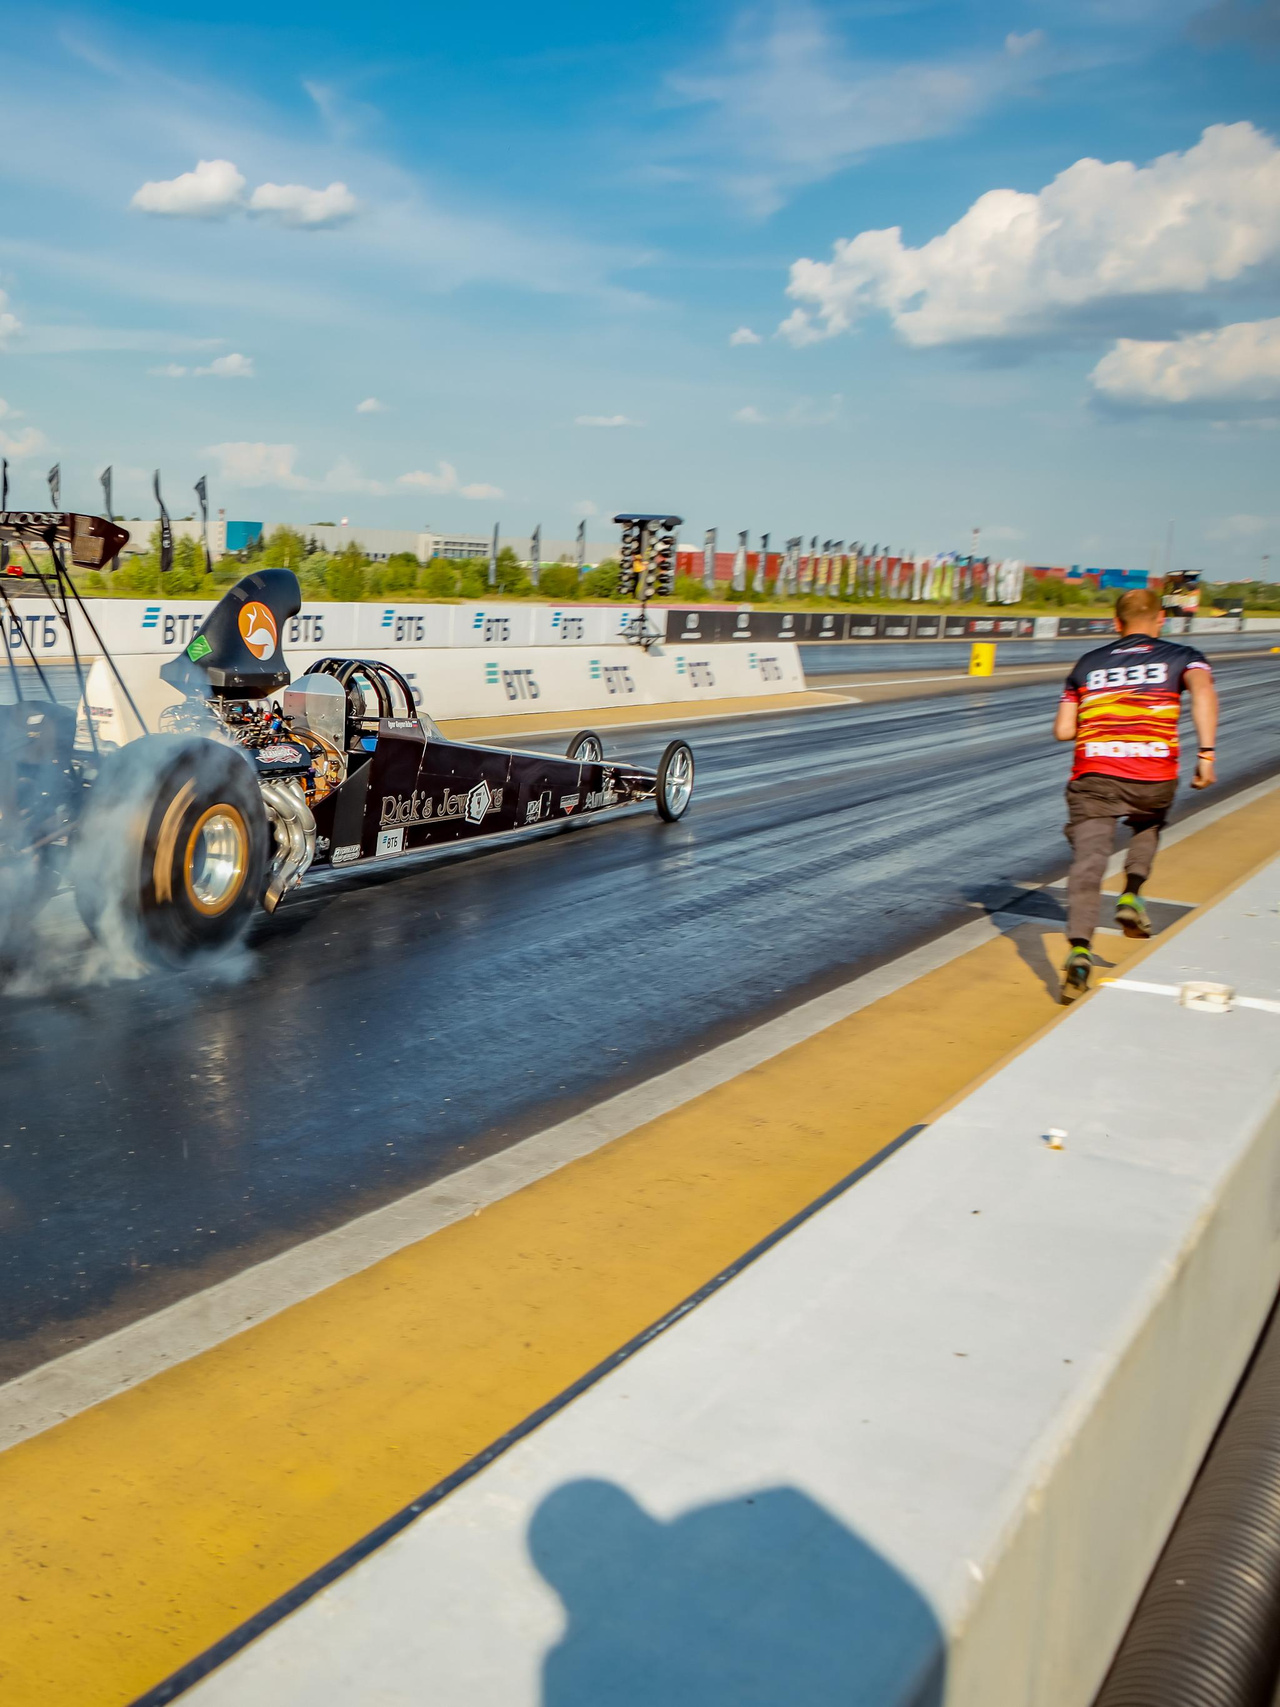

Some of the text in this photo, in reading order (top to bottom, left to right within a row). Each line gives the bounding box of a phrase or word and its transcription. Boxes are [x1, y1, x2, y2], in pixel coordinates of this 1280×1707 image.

[9, 616, 57, 649] ВТБ
[290, 615, 325, 643] ВТБ
[395, 616, 424, 642] ВТБ
[484, 618, 510, 642] ВТБ
[502, 669, 540, 700] ВТБ
[1086, 662, 1169, 691] 8333
[1085, 741, 1170, 758] RDRC
[379, 789, 433, 826] Rick's
[386, 836, 398, 849] ВТБ
